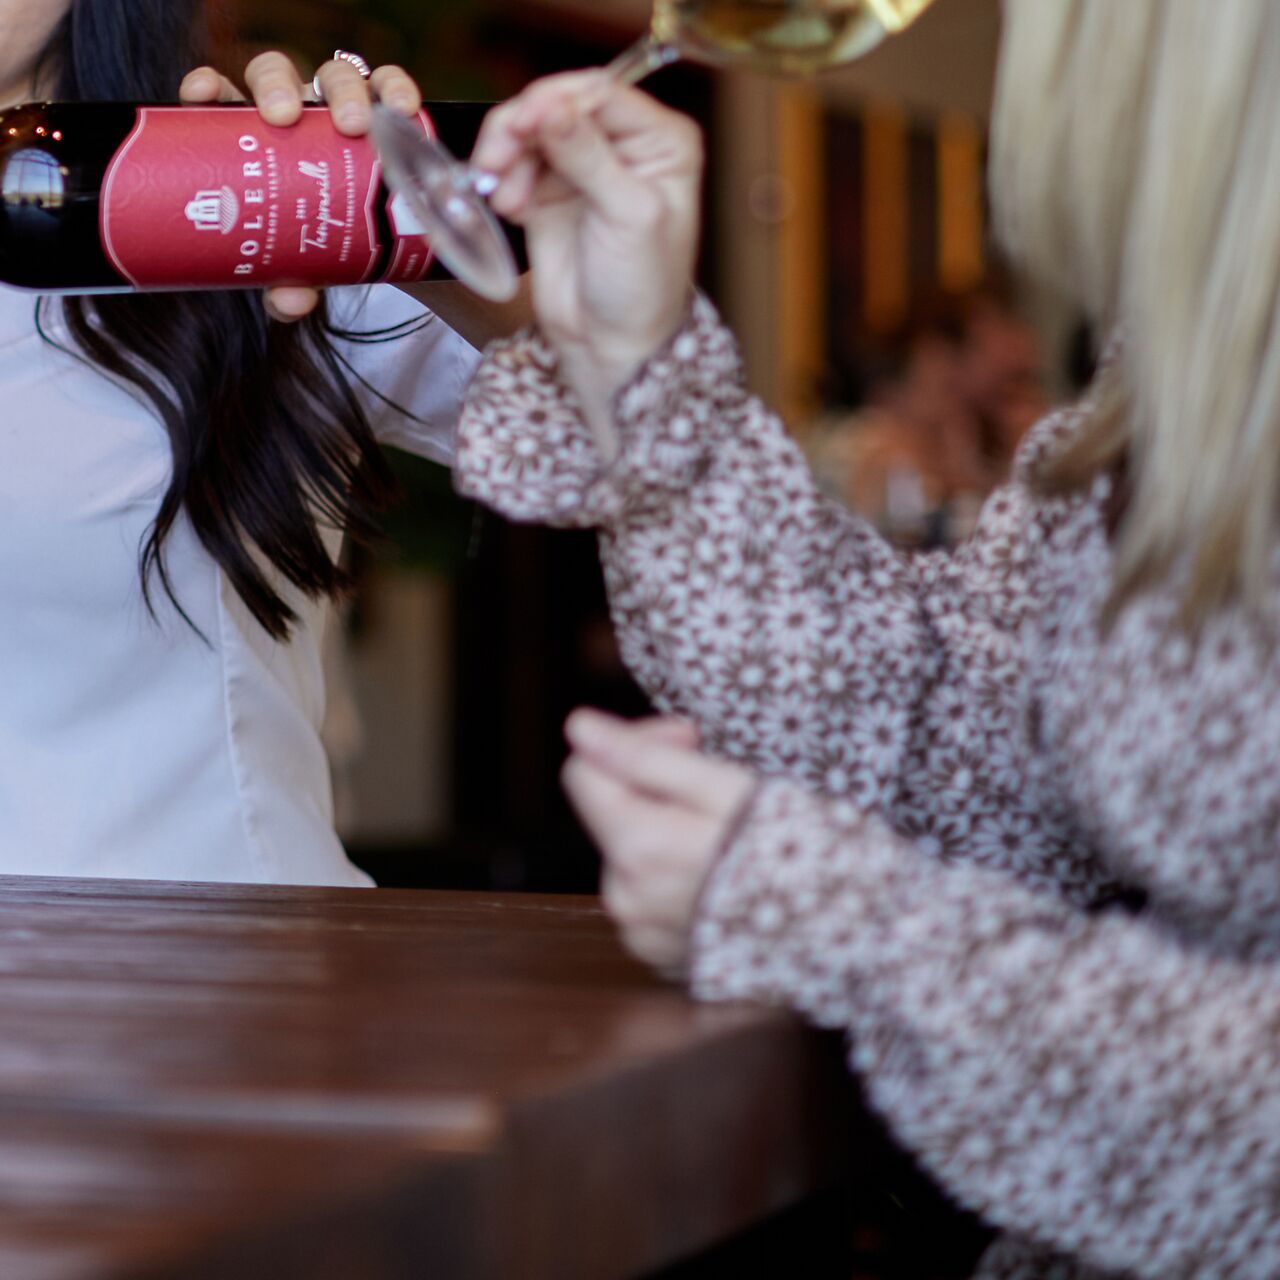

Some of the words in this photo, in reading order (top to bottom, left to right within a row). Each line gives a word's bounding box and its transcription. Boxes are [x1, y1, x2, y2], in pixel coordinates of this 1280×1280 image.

[233, 135, 264, 275] BOLERO
[265, 147, 279, 199] VILLAGE
[298, 160, 345, 253] Tempranillo
[265, 204, 278, 249] EUROPA
